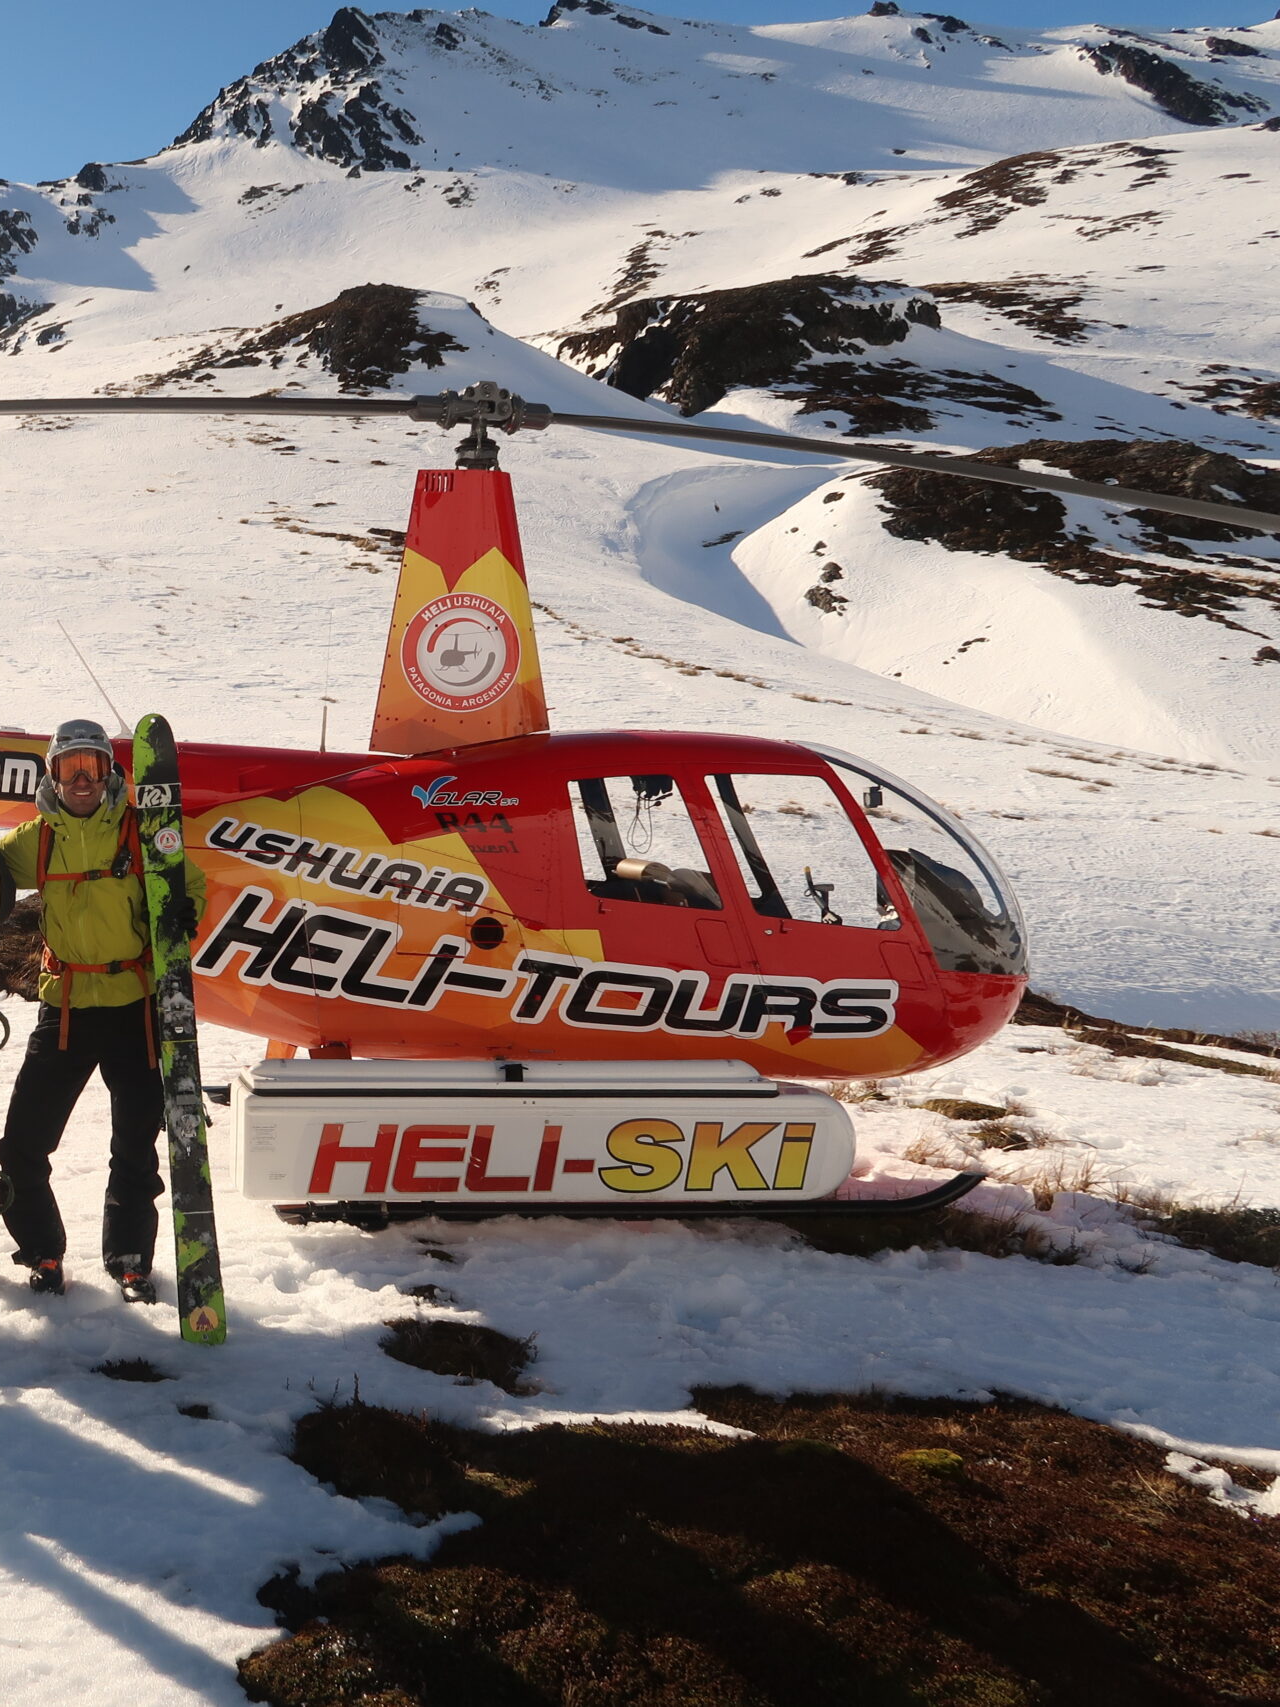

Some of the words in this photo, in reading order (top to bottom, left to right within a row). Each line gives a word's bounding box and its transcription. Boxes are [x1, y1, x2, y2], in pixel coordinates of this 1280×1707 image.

[421, 597, 452, 622] HELI
[453, 596, 506, 625] USHUAIA
[408, 666, 453, 707] PATAGONIA
[461, 671, 512, 708] ARGENTINA
[411, 776, 502, 809] VOLAR
[434, 812, 513, 833] R44
[192, 889, 898, 1037] HELI-TOURS
